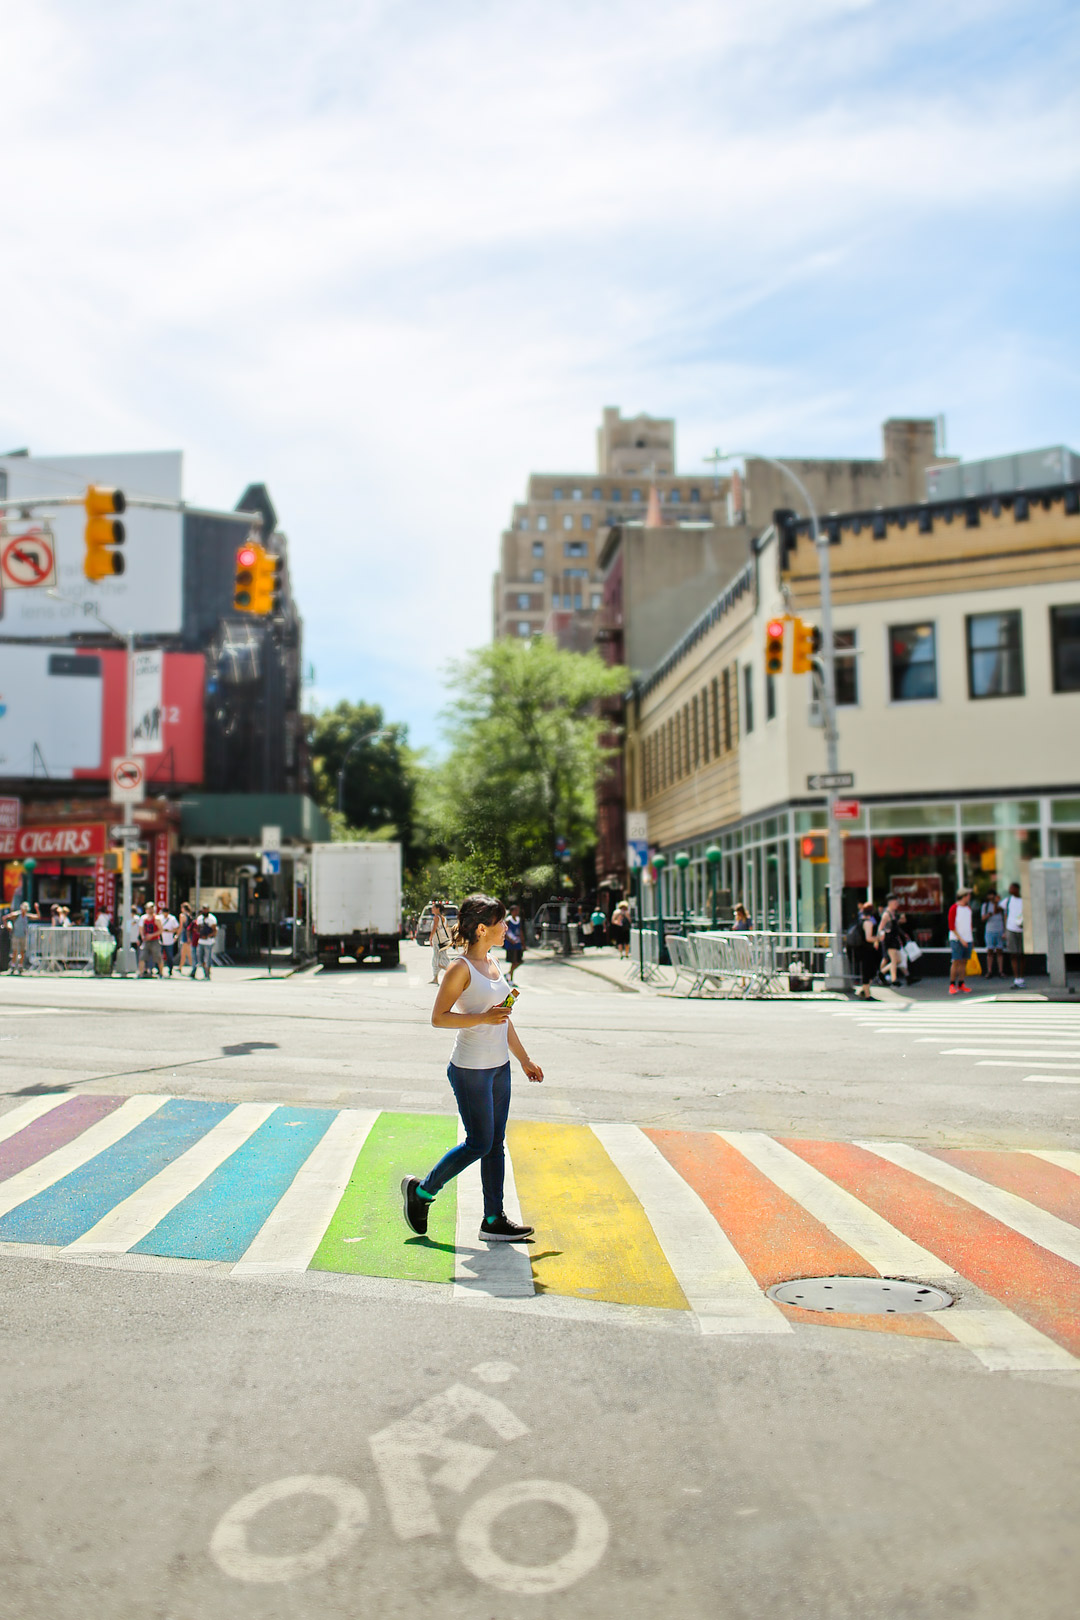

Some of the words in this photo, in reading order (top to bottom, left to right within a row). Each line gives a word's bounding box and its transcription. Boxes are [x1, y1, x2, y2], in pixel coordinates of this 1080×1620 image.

[83, 601, 98, 616] Pi
[631, 827, 646, 837] 20
[20, 830, 92, 854] CIGARS
